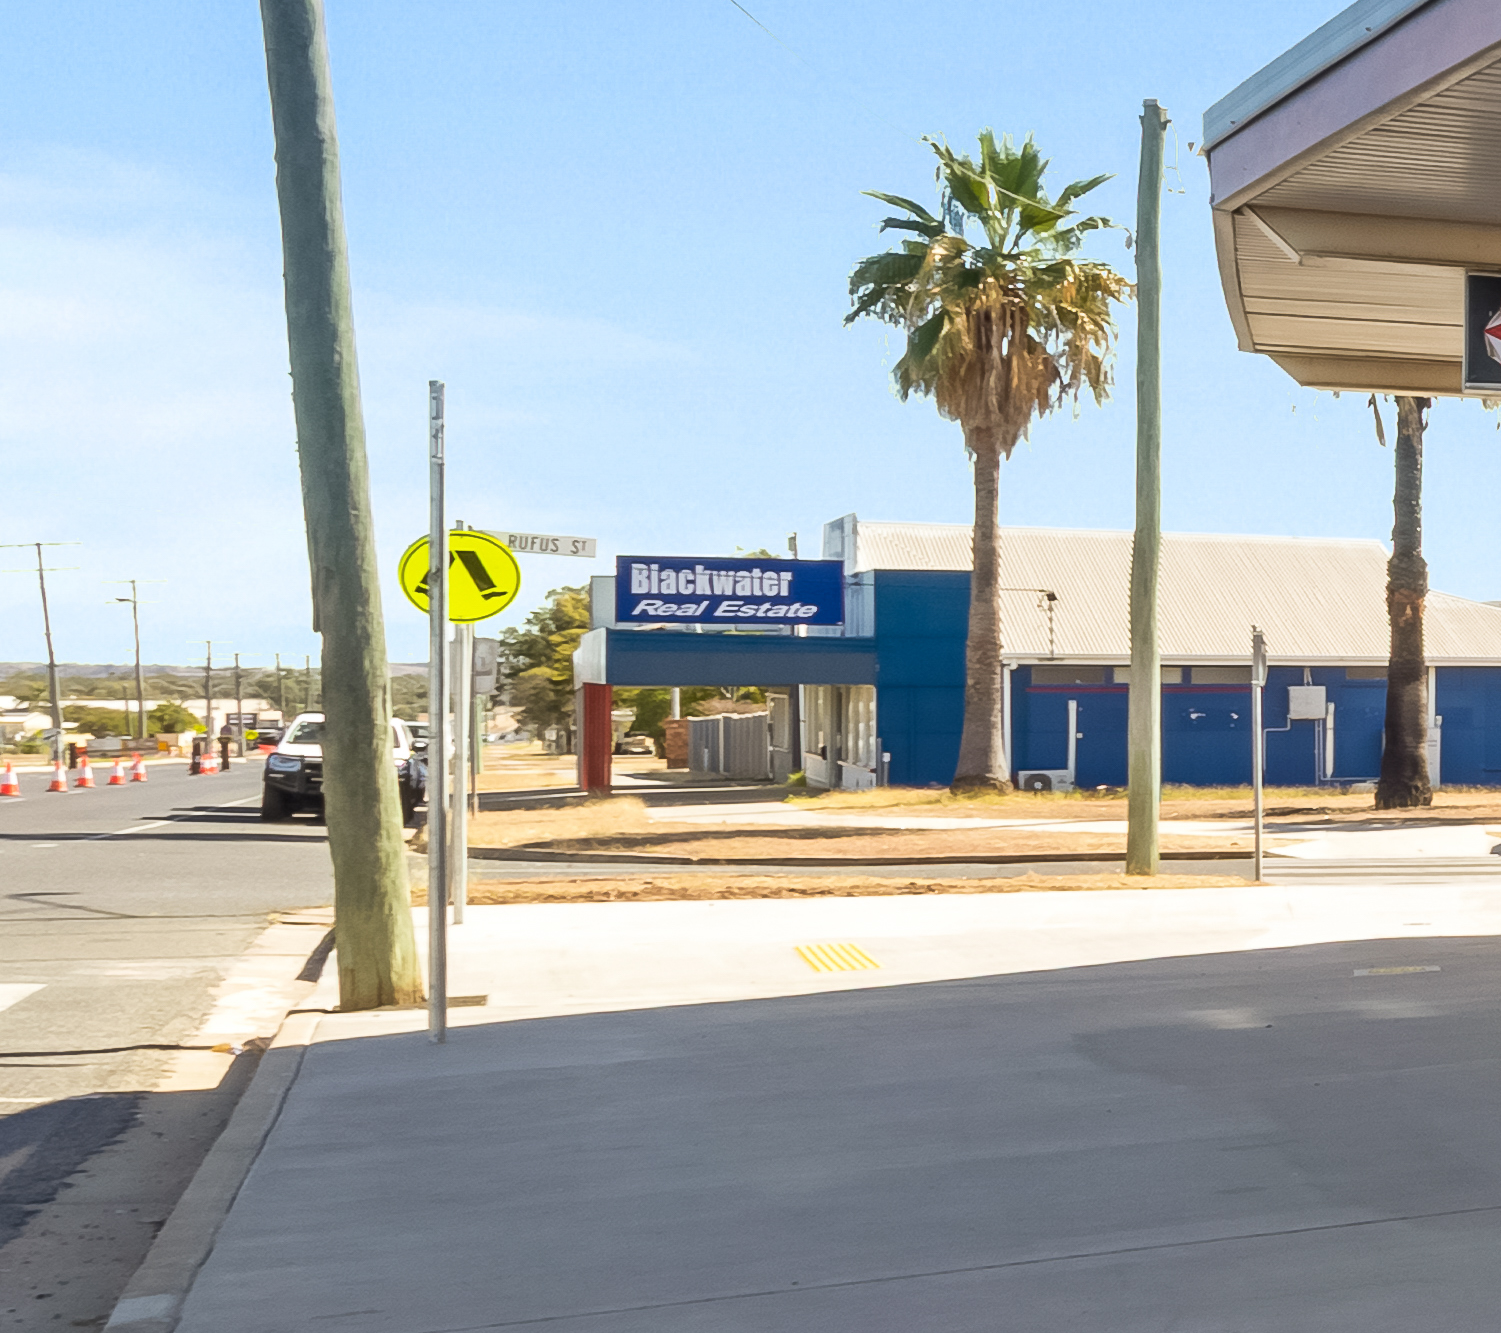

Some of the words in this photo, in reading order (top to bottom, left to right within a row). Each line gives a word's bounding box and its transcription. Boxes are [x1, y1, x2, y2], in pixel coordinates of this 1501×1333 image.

[508, 534, 560, 553] RUFUS
[631, 563, 793, 596] Blackwater
[631, 599, 710, 616] Real
[713, 600, 818, 618] Estate
